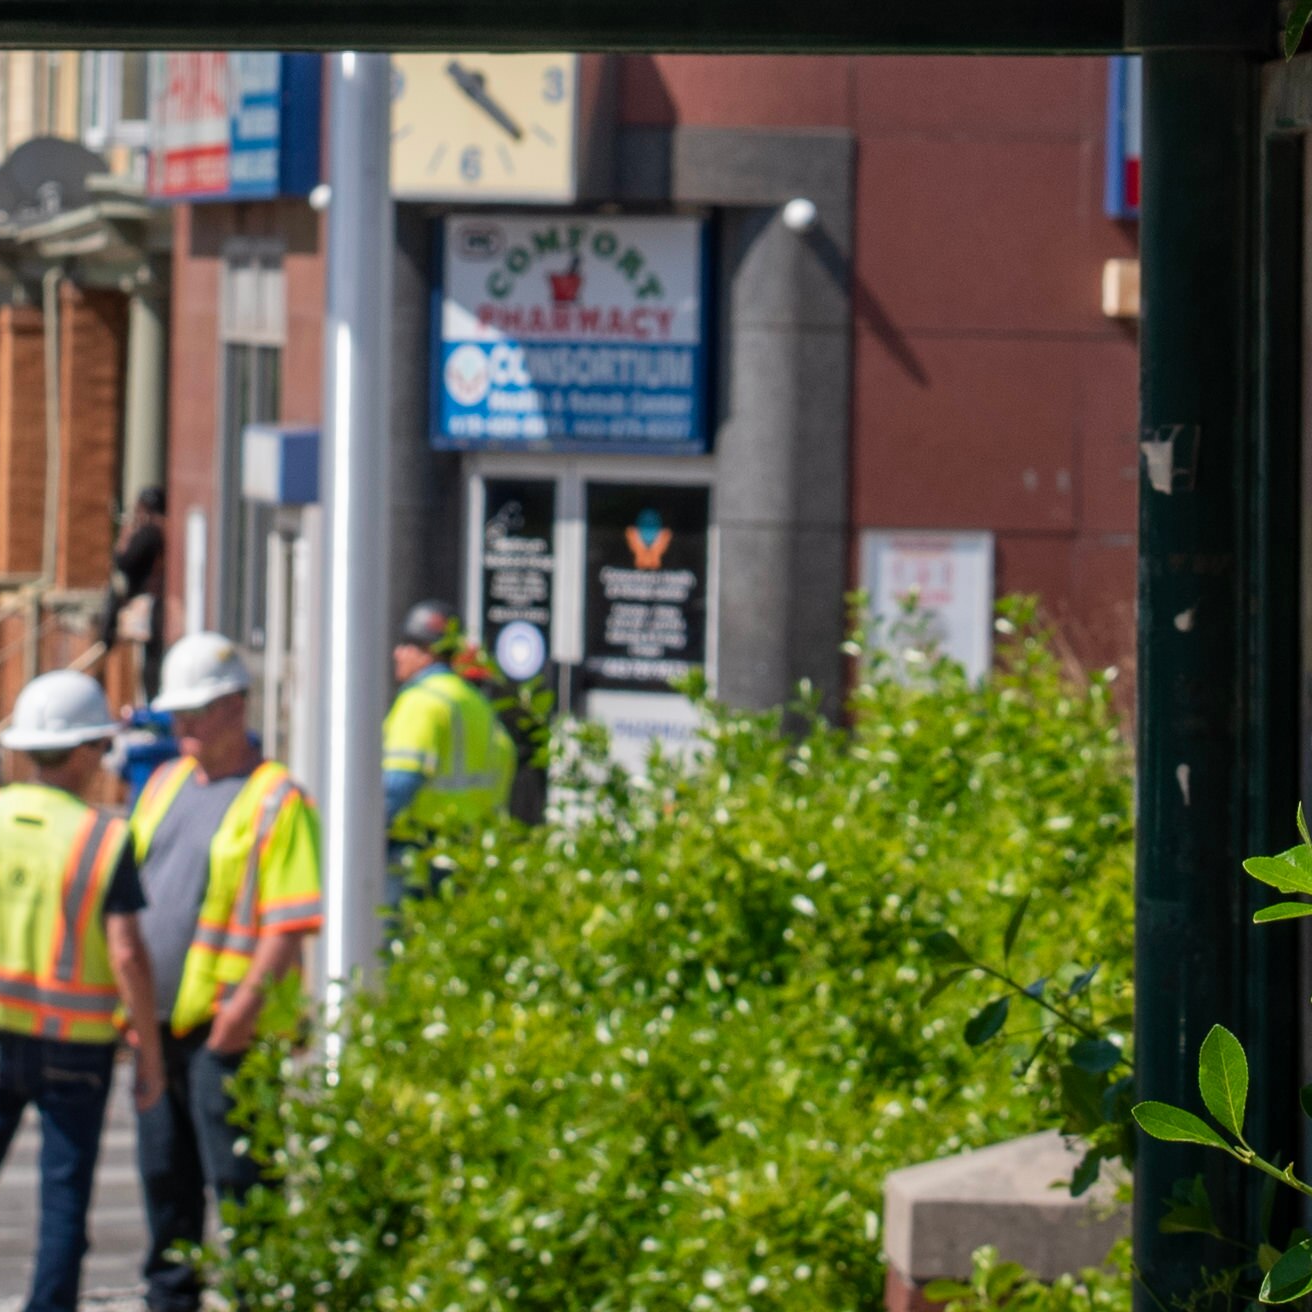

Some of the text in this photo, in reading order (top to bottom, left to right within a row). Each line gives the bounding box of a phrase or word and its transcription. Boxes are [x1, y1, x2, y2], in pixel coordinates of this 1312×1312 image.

[543, 65, 565, 105] 3
[460, 144, 482, 182] 6
[485, 226, 666, 301] COMFORT
[475, 303, 677, 339] PHARMACY
[488, 341, 693, 389] CONSORTIUM
